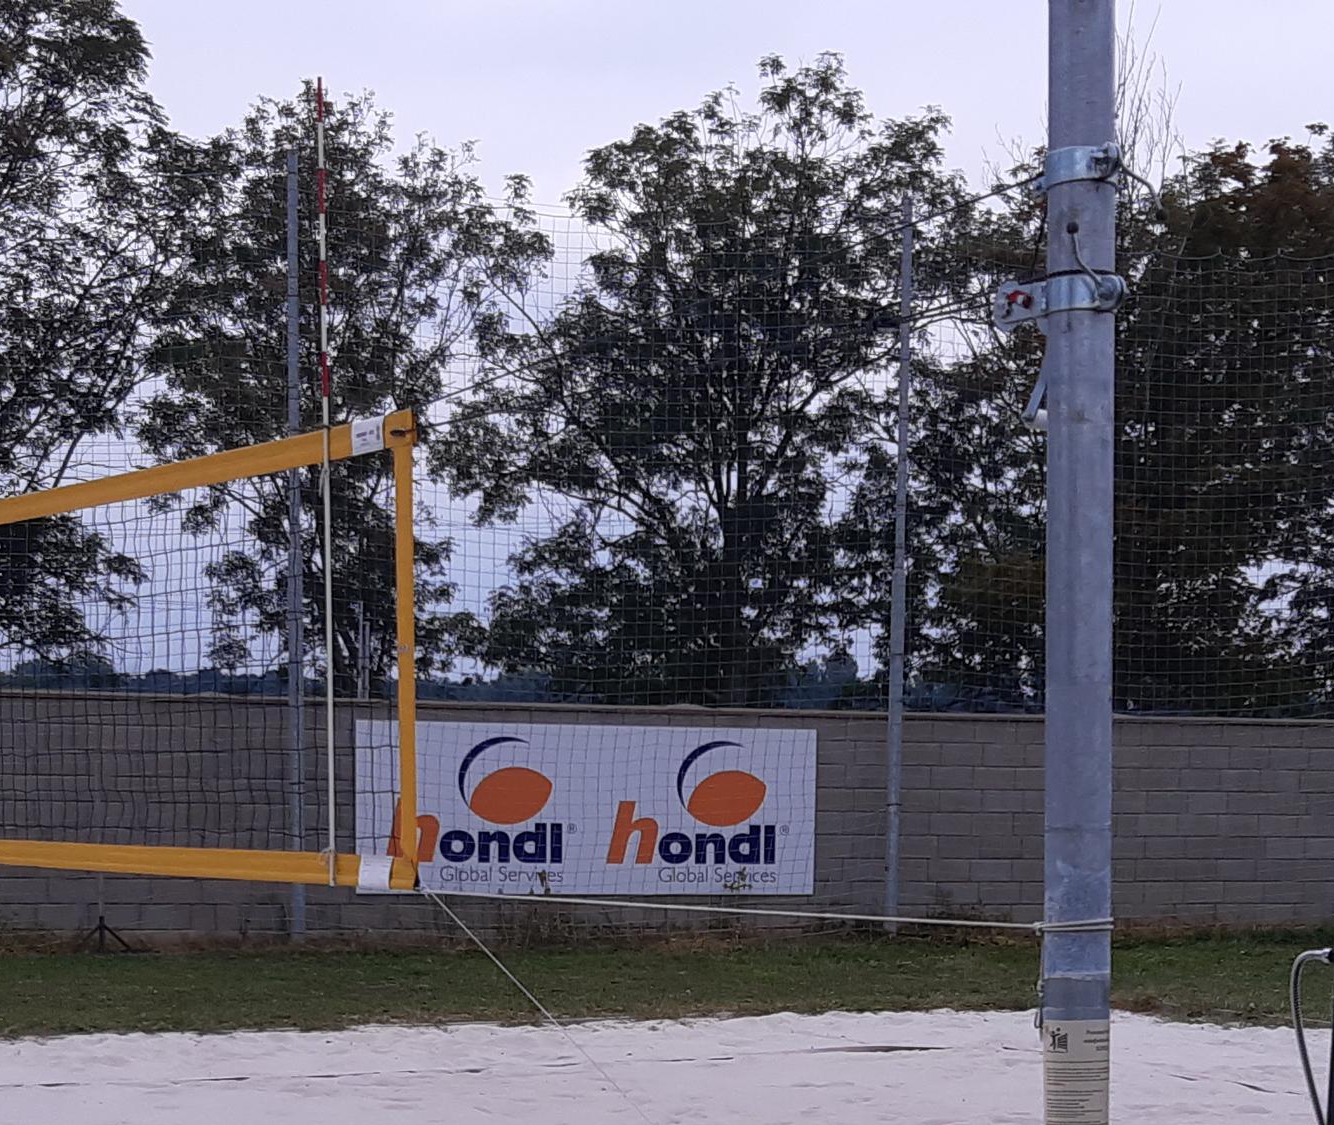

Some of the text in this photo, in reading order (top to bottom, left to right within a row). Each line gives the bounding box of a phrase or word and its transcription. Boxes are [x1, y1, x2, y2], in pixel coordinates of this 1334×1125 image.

[606, 800, 777, 865] hondl
[439, 865, 564, 883] Global Servies
[657, 867, 709, 883] Global
